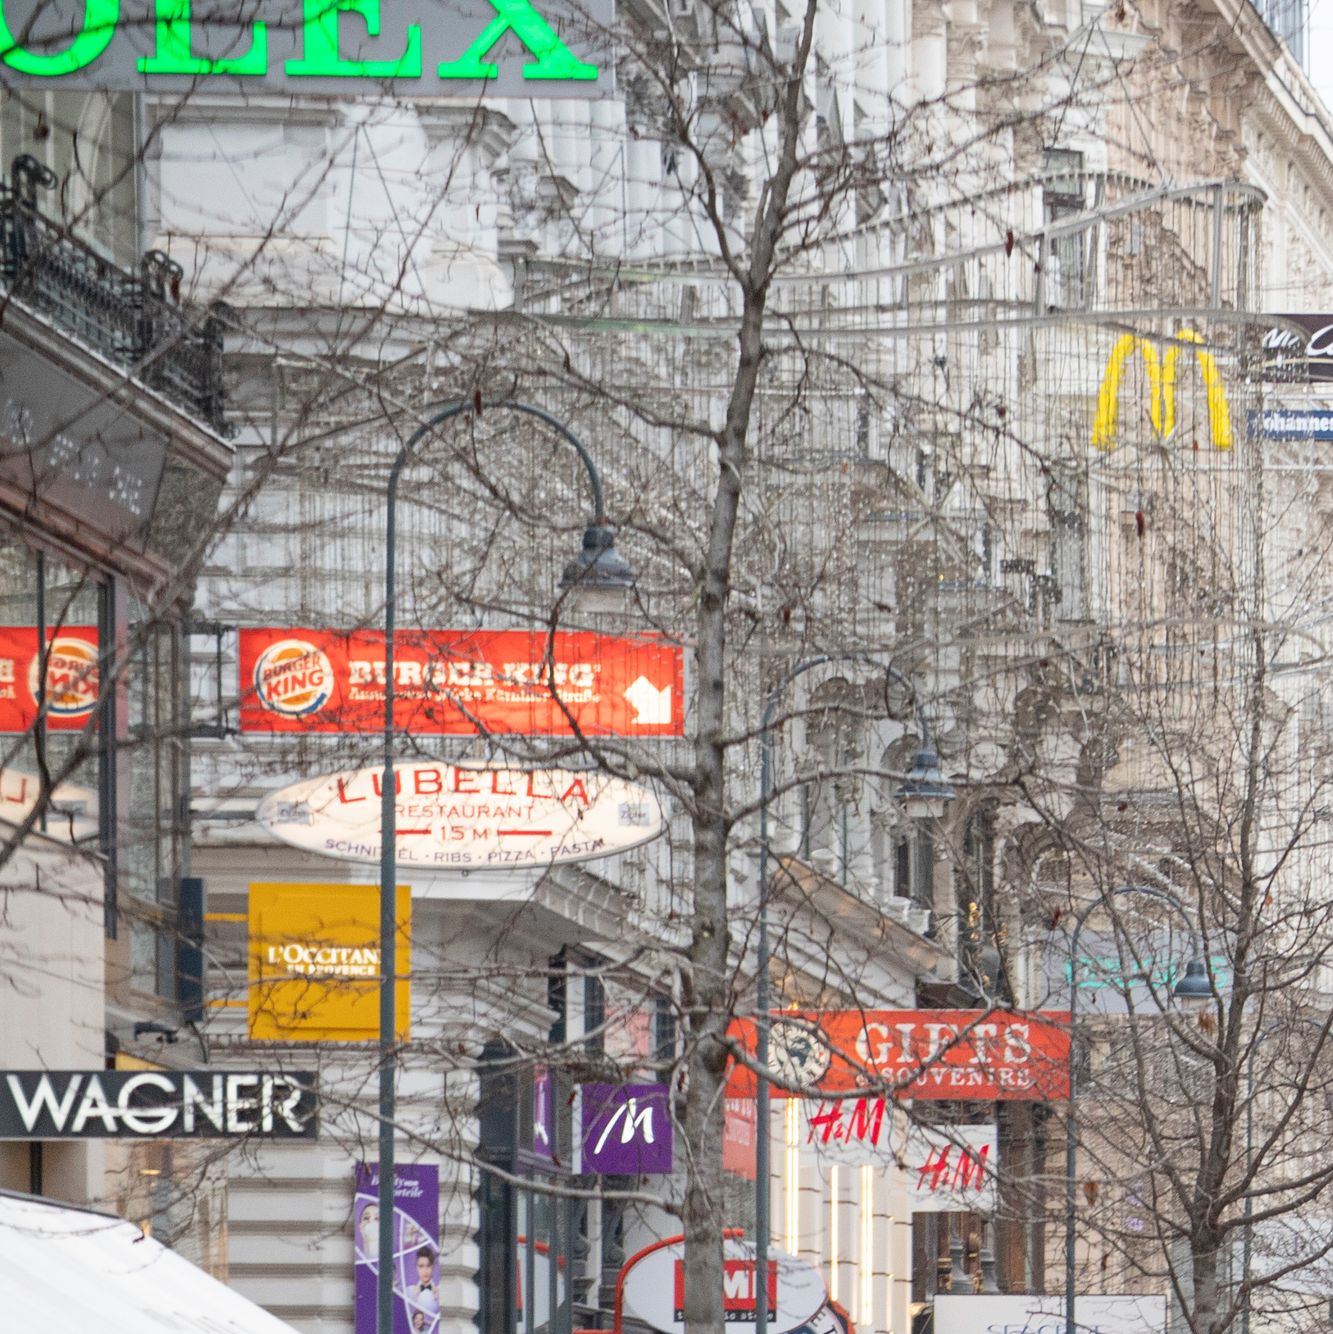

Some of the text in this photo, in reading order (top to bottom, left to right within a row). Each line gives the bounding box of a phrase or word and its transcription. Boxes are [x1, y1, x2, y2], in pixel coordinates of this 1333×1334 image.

[266, 669, 324, 700] KING
[349, 661, 595, 687] BURGER KING
[394, 804, 534, 820] RESTAURANT
[324, 839, 418, 861] SCHNIEL
[434, 852, 471, 863] RIBS
[268, 943, 382, 964] L'OCCITAN
[855, 1023, 1032, 1064] GIFTS
[5, 1073, 306, 1134] WAGNER
[806, 1096, 886, 1147] H&M
[916, 1143, 991, 1193] H&M
